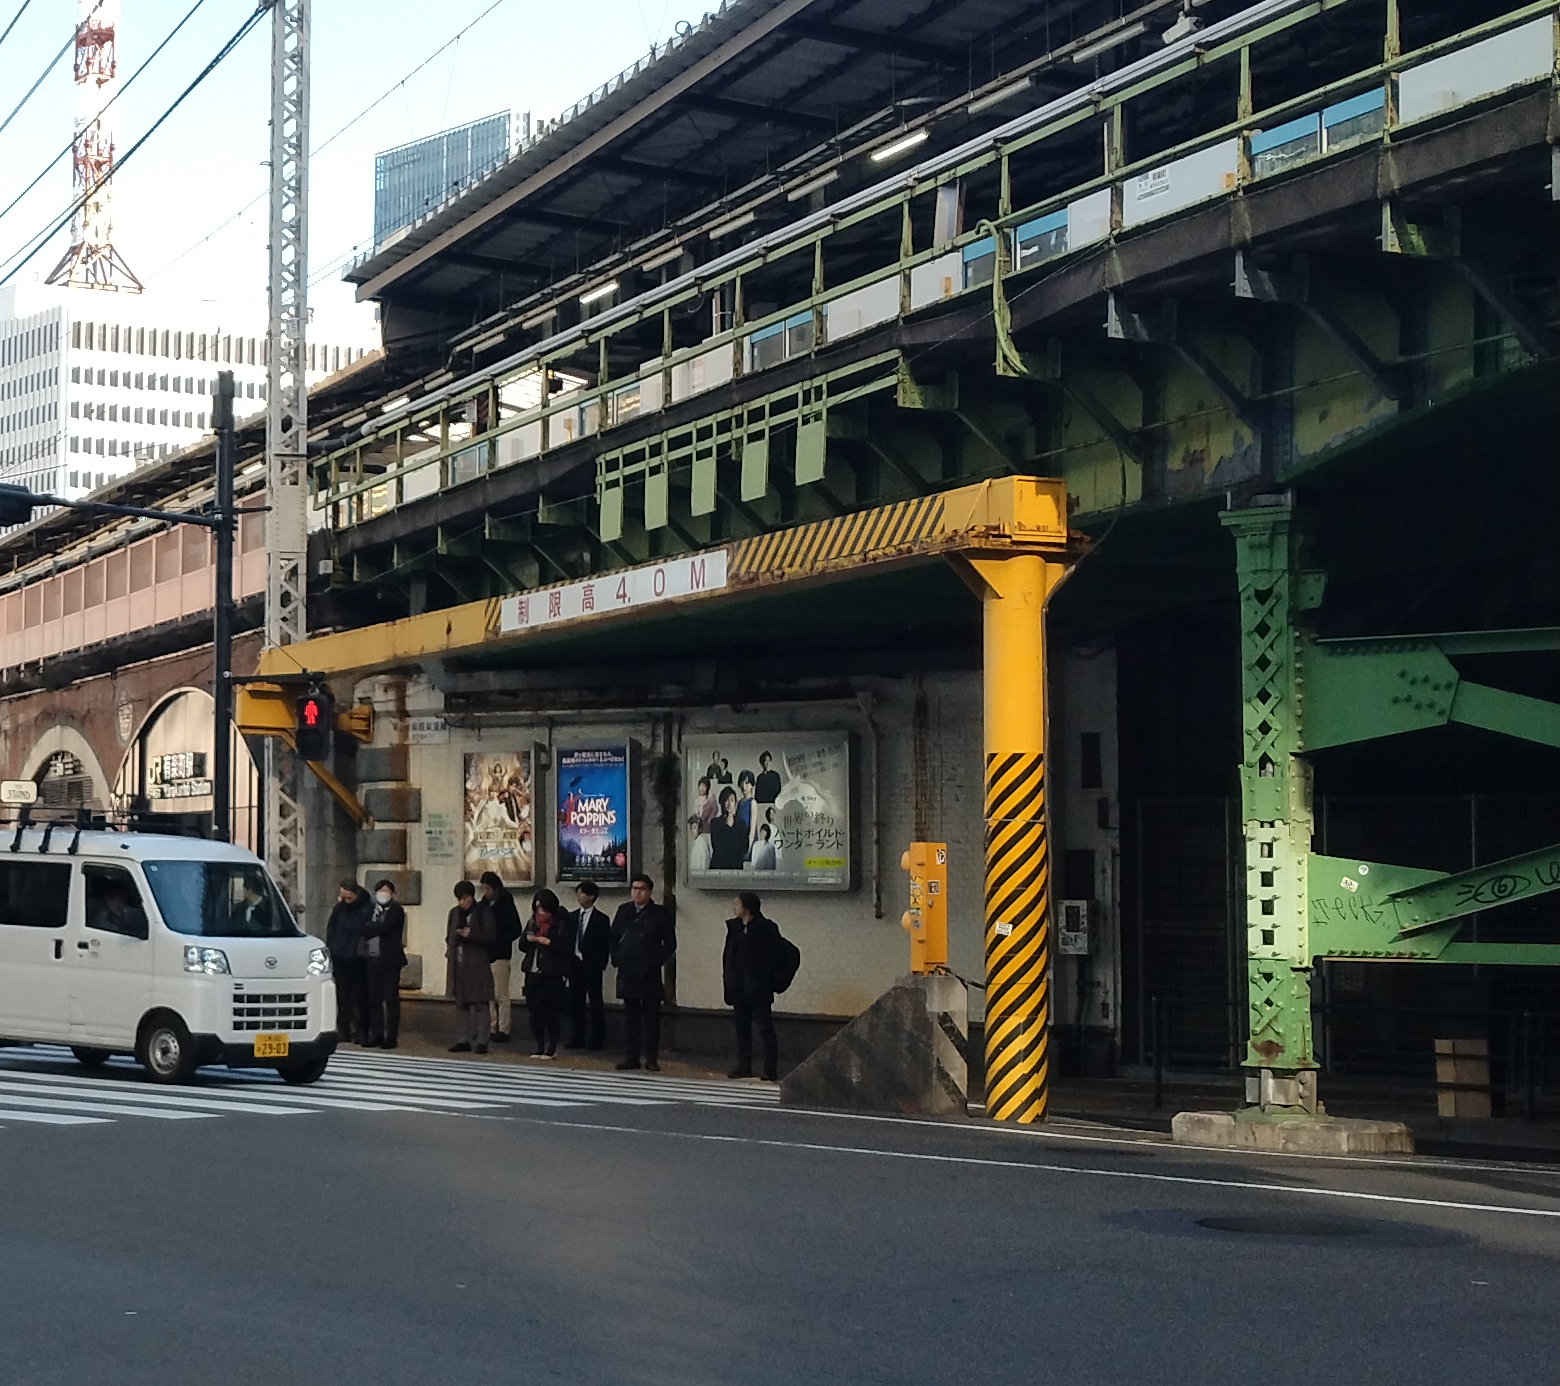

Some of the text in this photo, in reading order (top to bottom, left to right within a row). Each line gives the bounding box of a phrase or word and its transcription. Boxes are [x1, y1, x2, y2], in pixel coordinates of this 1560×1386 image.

[147, 755, 161, 785] JR
[578, 797, 610, 813] MARY
[570, 810, 617, 827] POPPINS
